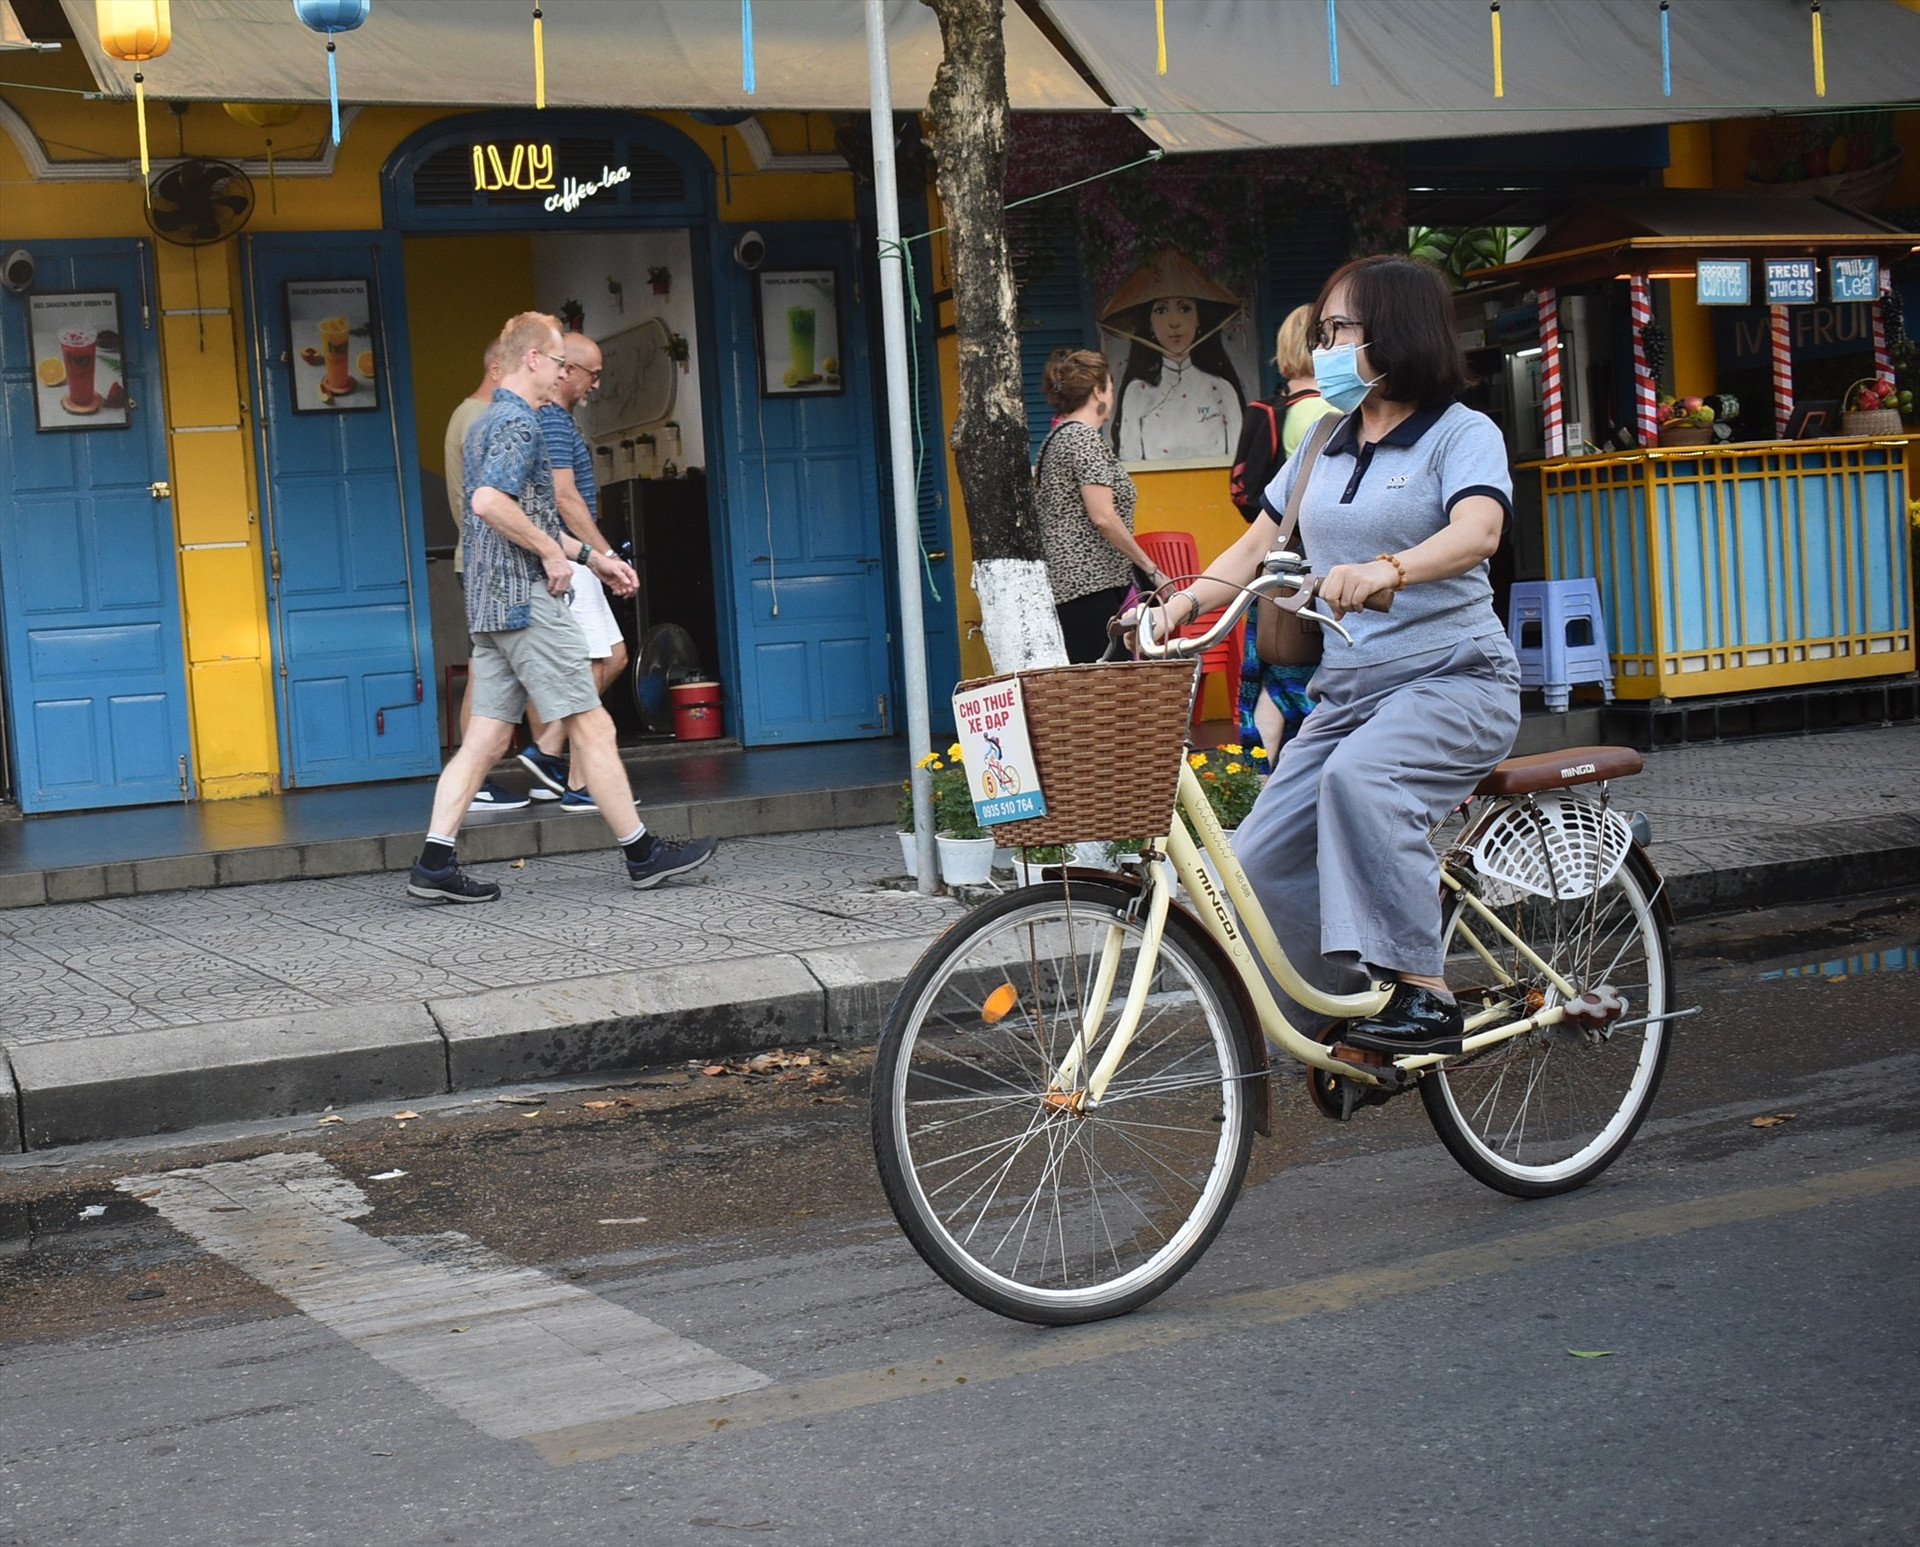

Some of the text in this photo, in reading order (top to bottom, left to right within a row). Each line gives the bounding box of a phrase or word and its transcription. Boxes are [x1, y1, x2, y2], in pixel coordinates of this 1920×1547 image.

[1768, 264, 1809, 279] FRESH
[1769, 279, 1814, 297] JUICES
[1836, 276, 1873, 297] tea
[1735, 301, 1868, 357] IV FRUI
[959, 688, 1015, 718] CHO THUÊ
[968, 717, 983, 734] XE
[986, 776, 994, 793] 5
[982, 797, 1034, 818] 0935 510 764
